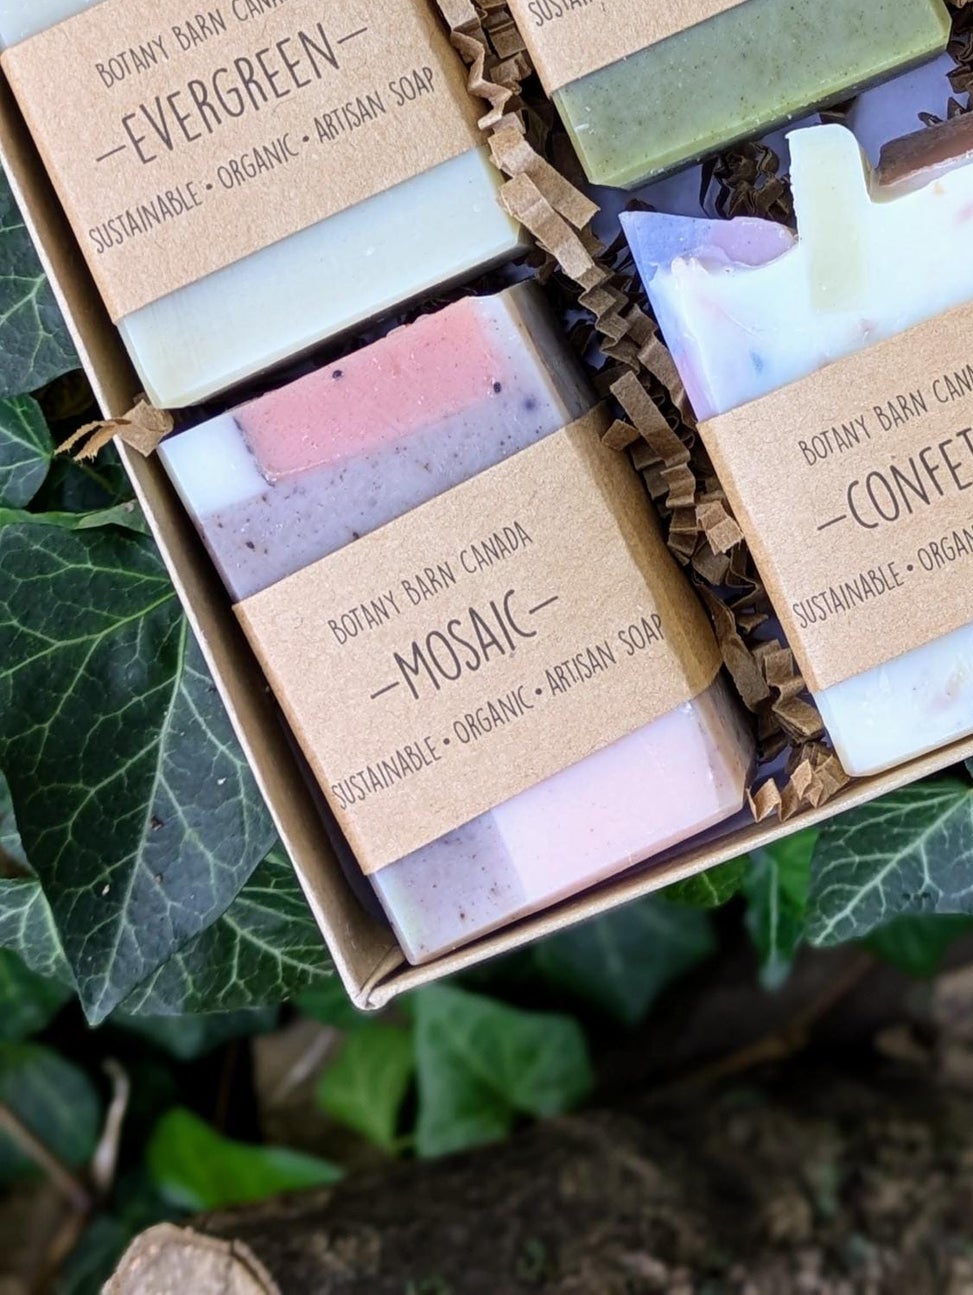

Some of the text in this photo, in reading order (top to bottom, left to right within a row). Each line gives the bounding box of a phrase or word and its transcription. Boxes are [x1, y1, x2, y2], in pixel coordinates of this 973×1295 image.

[95, 35, 169, 88] BOTANY
[172, 8, 225, 51] BARN
[88, 66, 436, 254] SUSTAINABLE ORGANIC ARTISAN SOAP
[798, 416, 870, 466] BOTANY
[873, 390, 928, 431] BARN
[328, 521, 533, 645] BOTANY BARN CANADA
[792, 562, 904, 629] SUSTAINABLE
[331, 613, 665, 810] SUSTAINABLE ORGANIC ARTISAN SOAP
